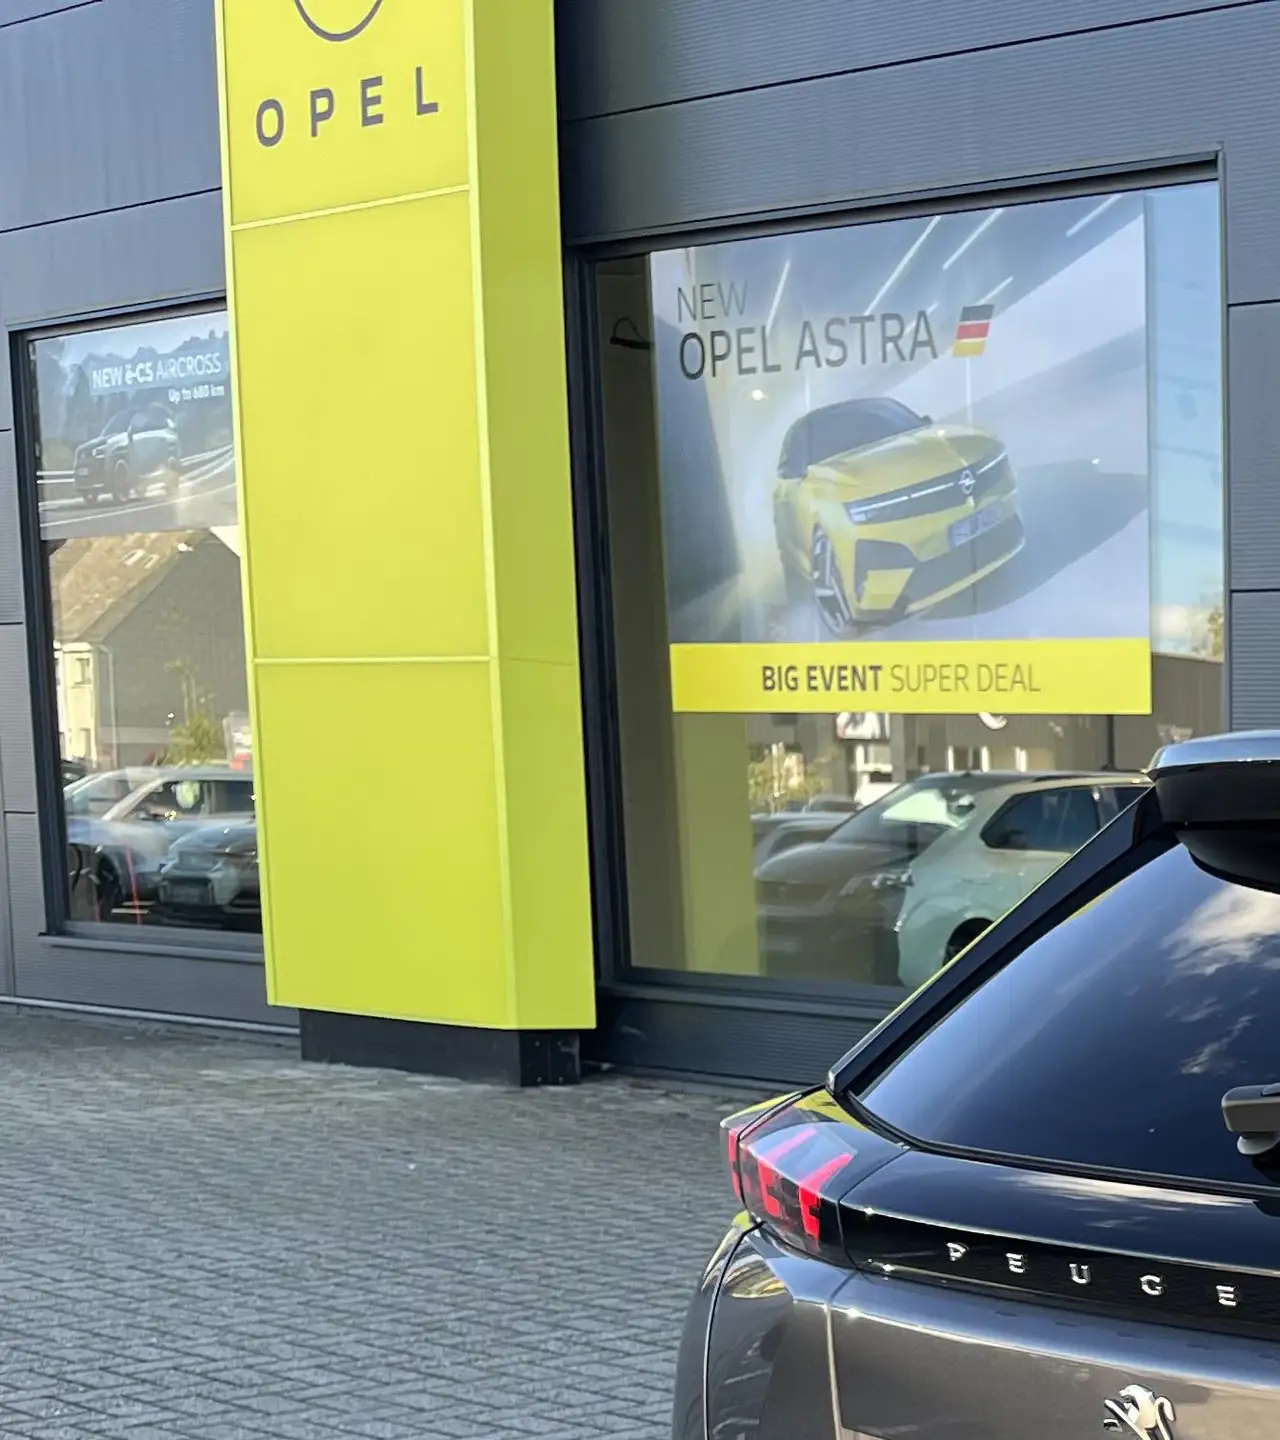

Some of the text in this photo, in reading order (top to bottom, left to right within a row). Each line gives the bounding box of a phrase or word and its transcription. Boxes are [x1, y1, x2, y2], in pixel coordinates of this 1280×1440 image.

[256, 66, 439, 147] OPEL
[677, 278, 748, 323] NEW
[679, 309, 939, 381] OPEL ASTRA
[92, 366, 123, 389] NEW
[155, 352, 222, 381] AIRCROSS
[168, 387, 181, 404] Up
[211, 384, 226, 398] km
[761, 662, 1042, 693] BIG EVENT SUPER DEAL
